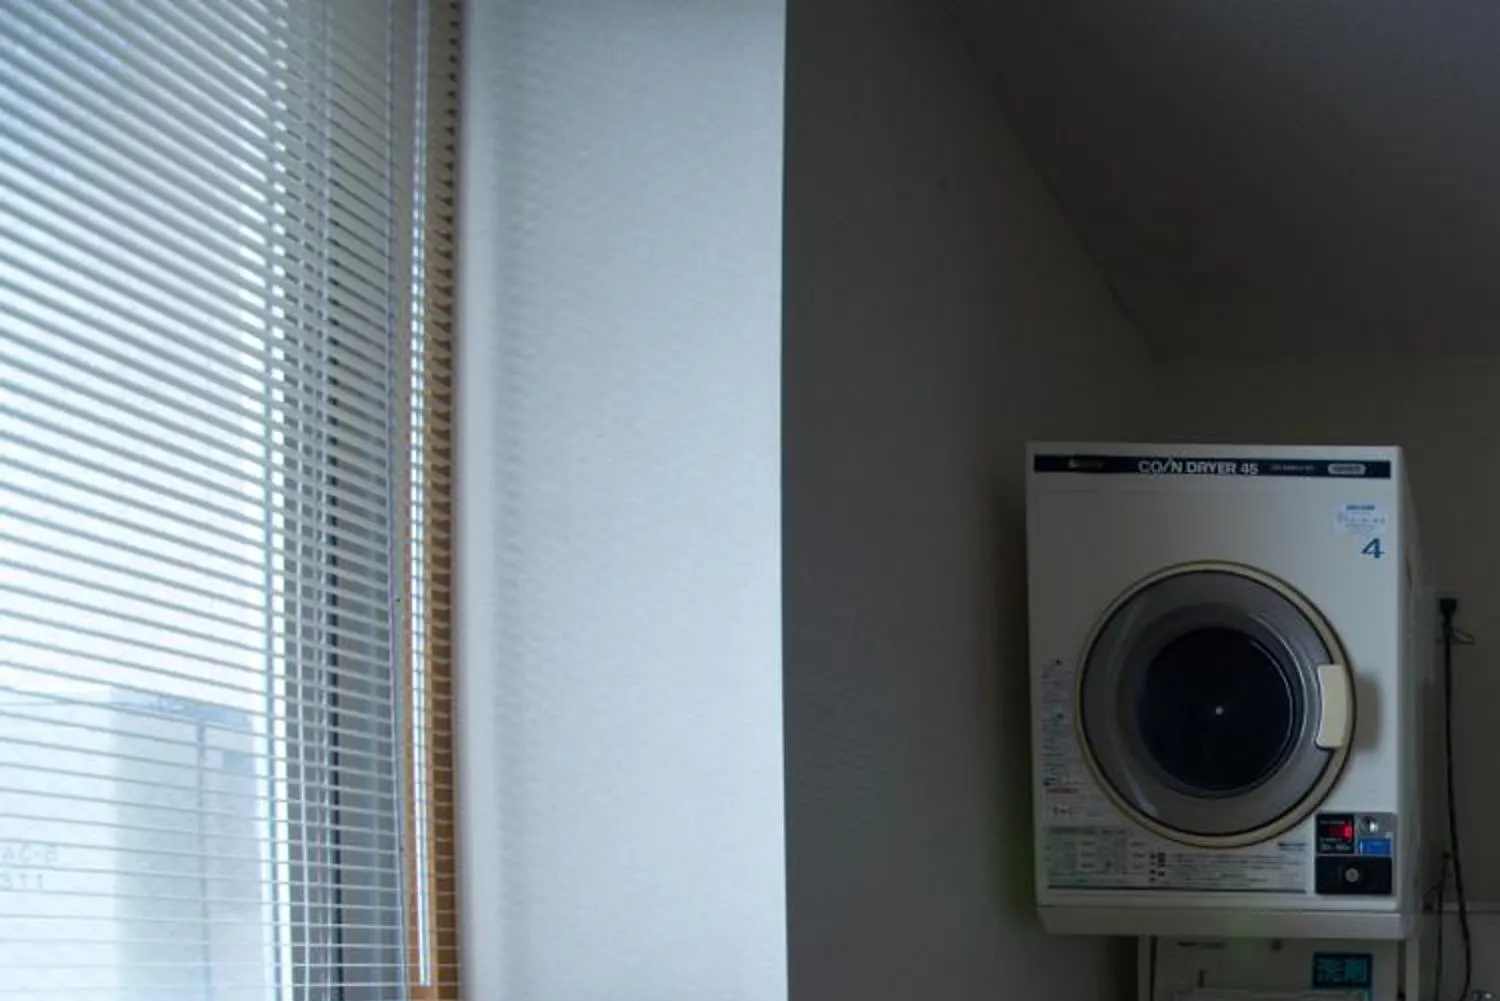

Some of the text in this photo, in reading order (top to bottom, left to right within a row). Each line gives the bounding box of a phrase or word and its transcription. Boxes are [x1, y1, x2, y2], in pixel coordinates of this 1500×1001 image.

[1186, 461, 1237, 475] DRYER
[1239, 462, 1260, 475] 45
[1361, 537, 1384, 559] 4
